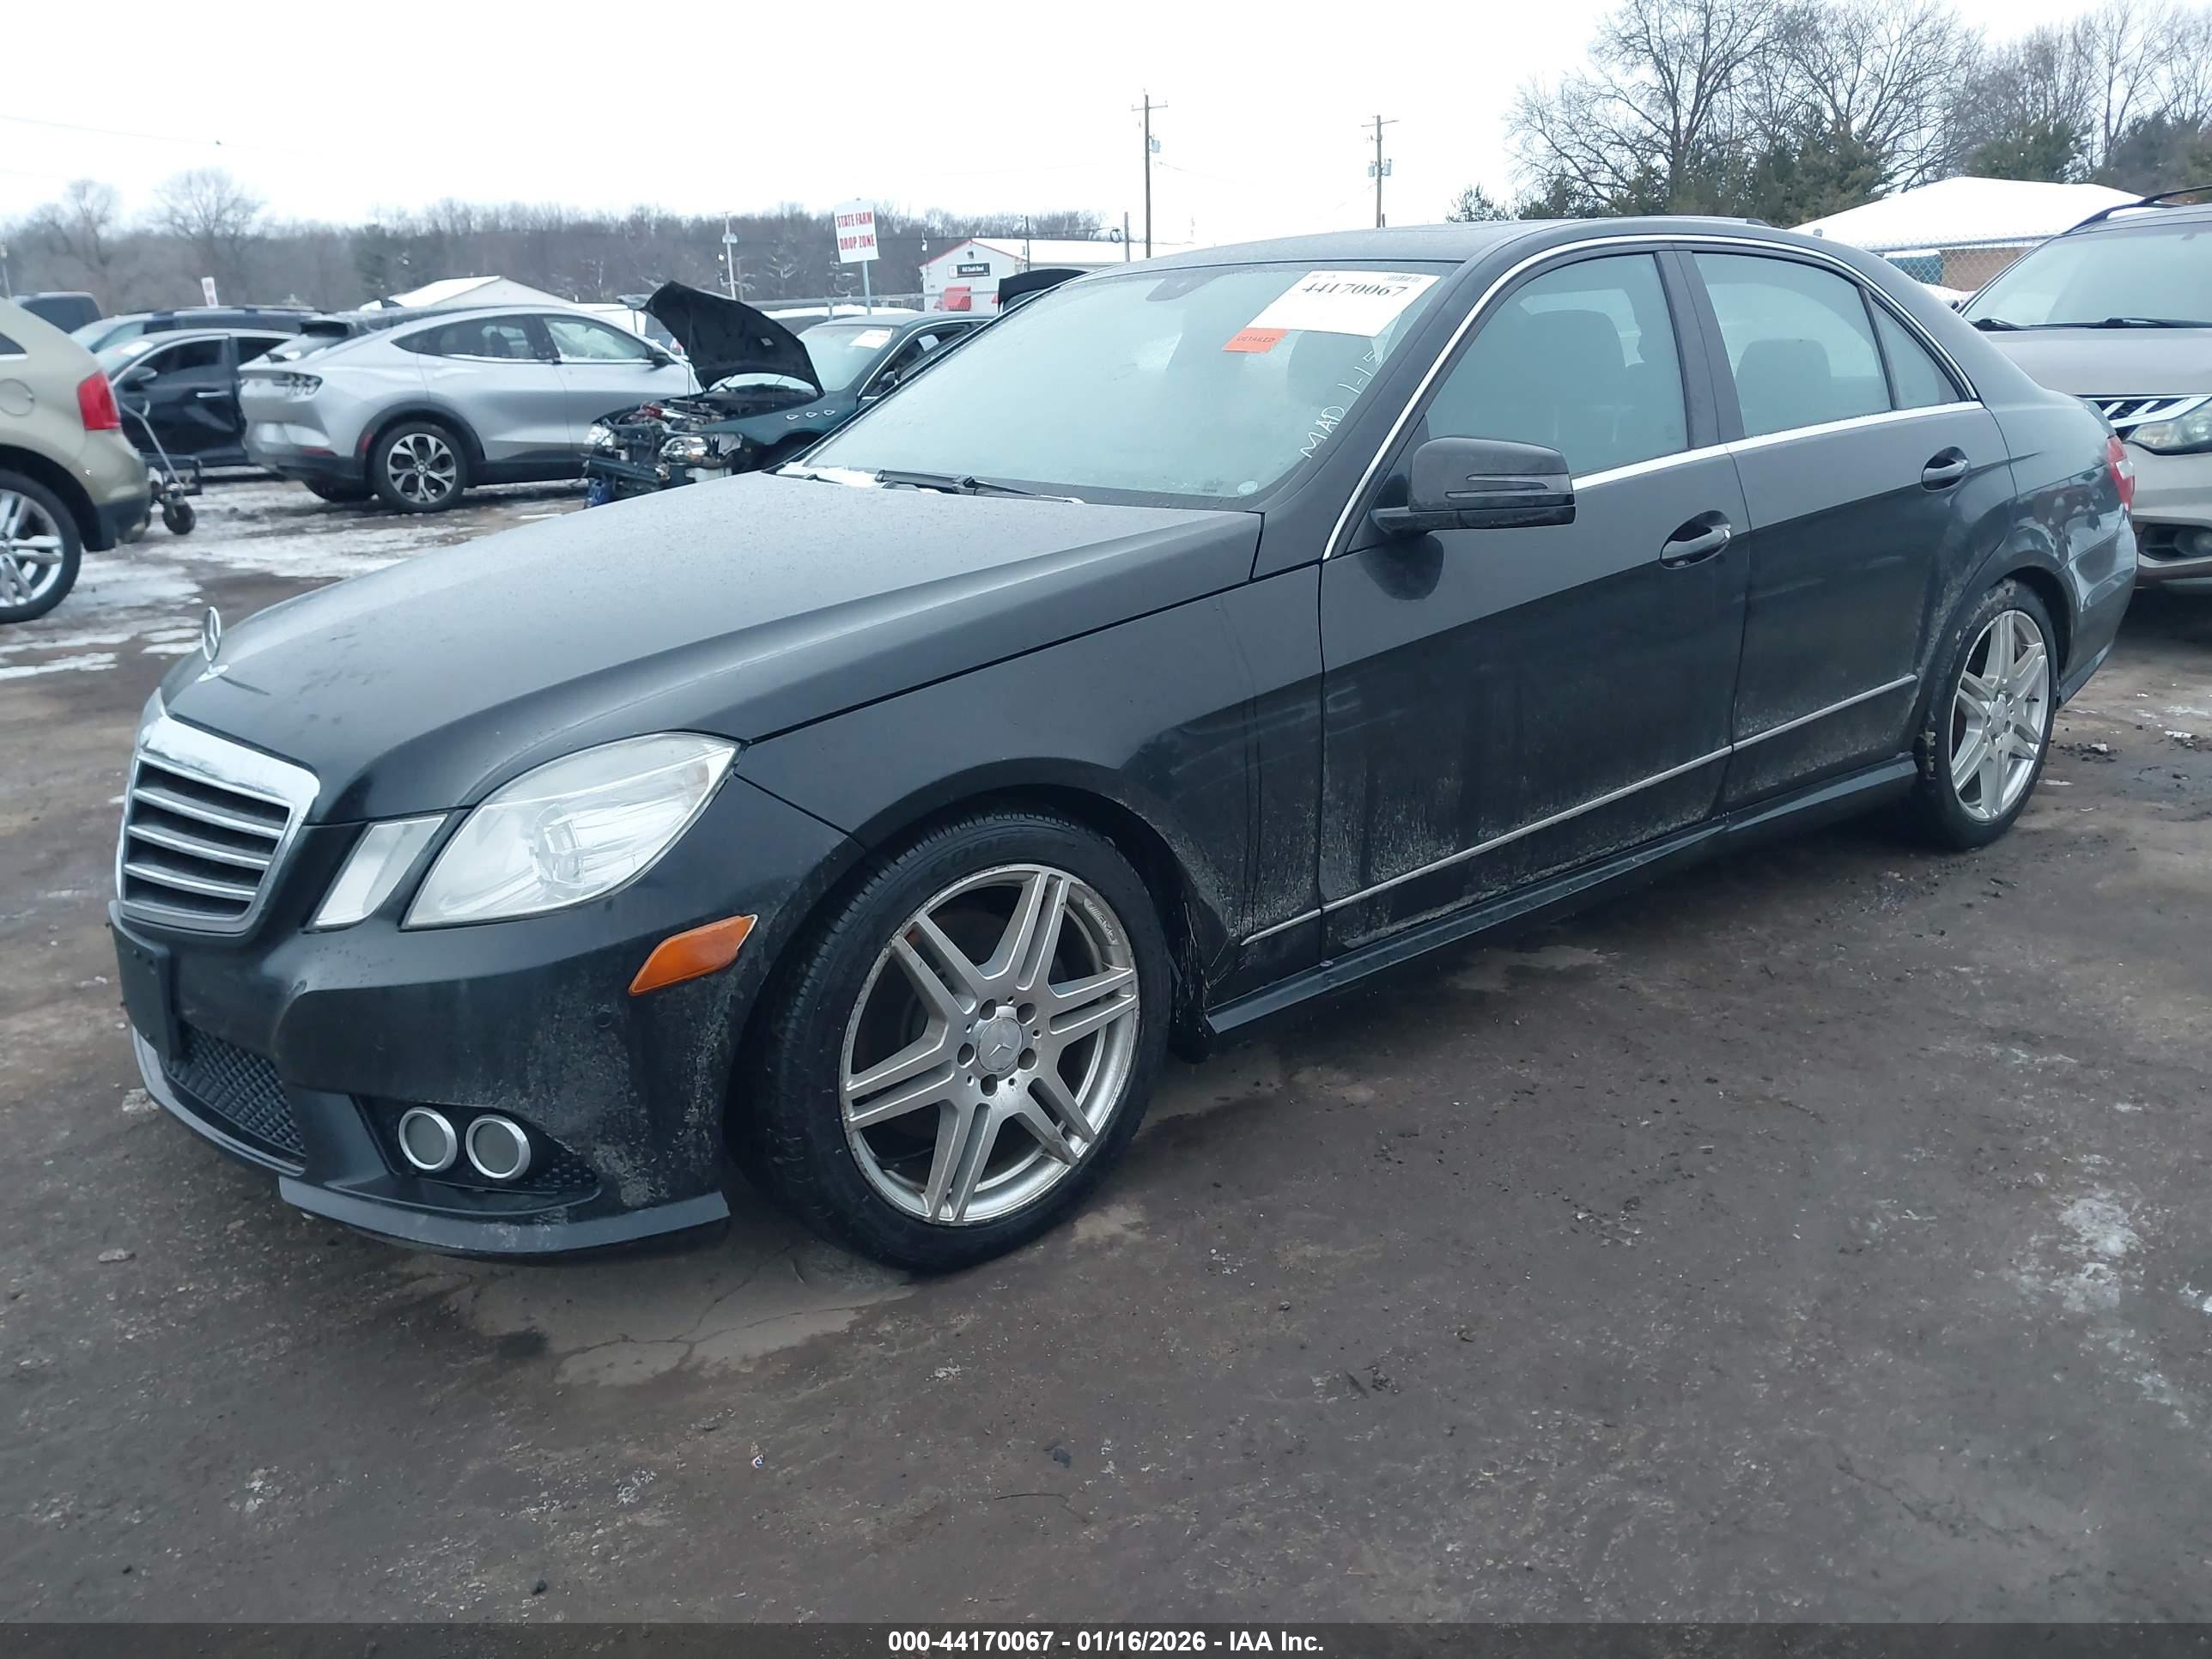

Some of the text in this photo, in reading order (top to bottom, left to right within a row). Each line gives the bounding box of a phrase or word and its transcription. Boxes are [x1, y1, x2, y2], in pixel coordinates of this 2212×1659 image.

[837, 214, 855, 228] STATE
[840, 234, 875, 250] DROP ZONE
[1302, 282, 1409, 297] 44170067
[1299, 405, 1345, 459] MAD
